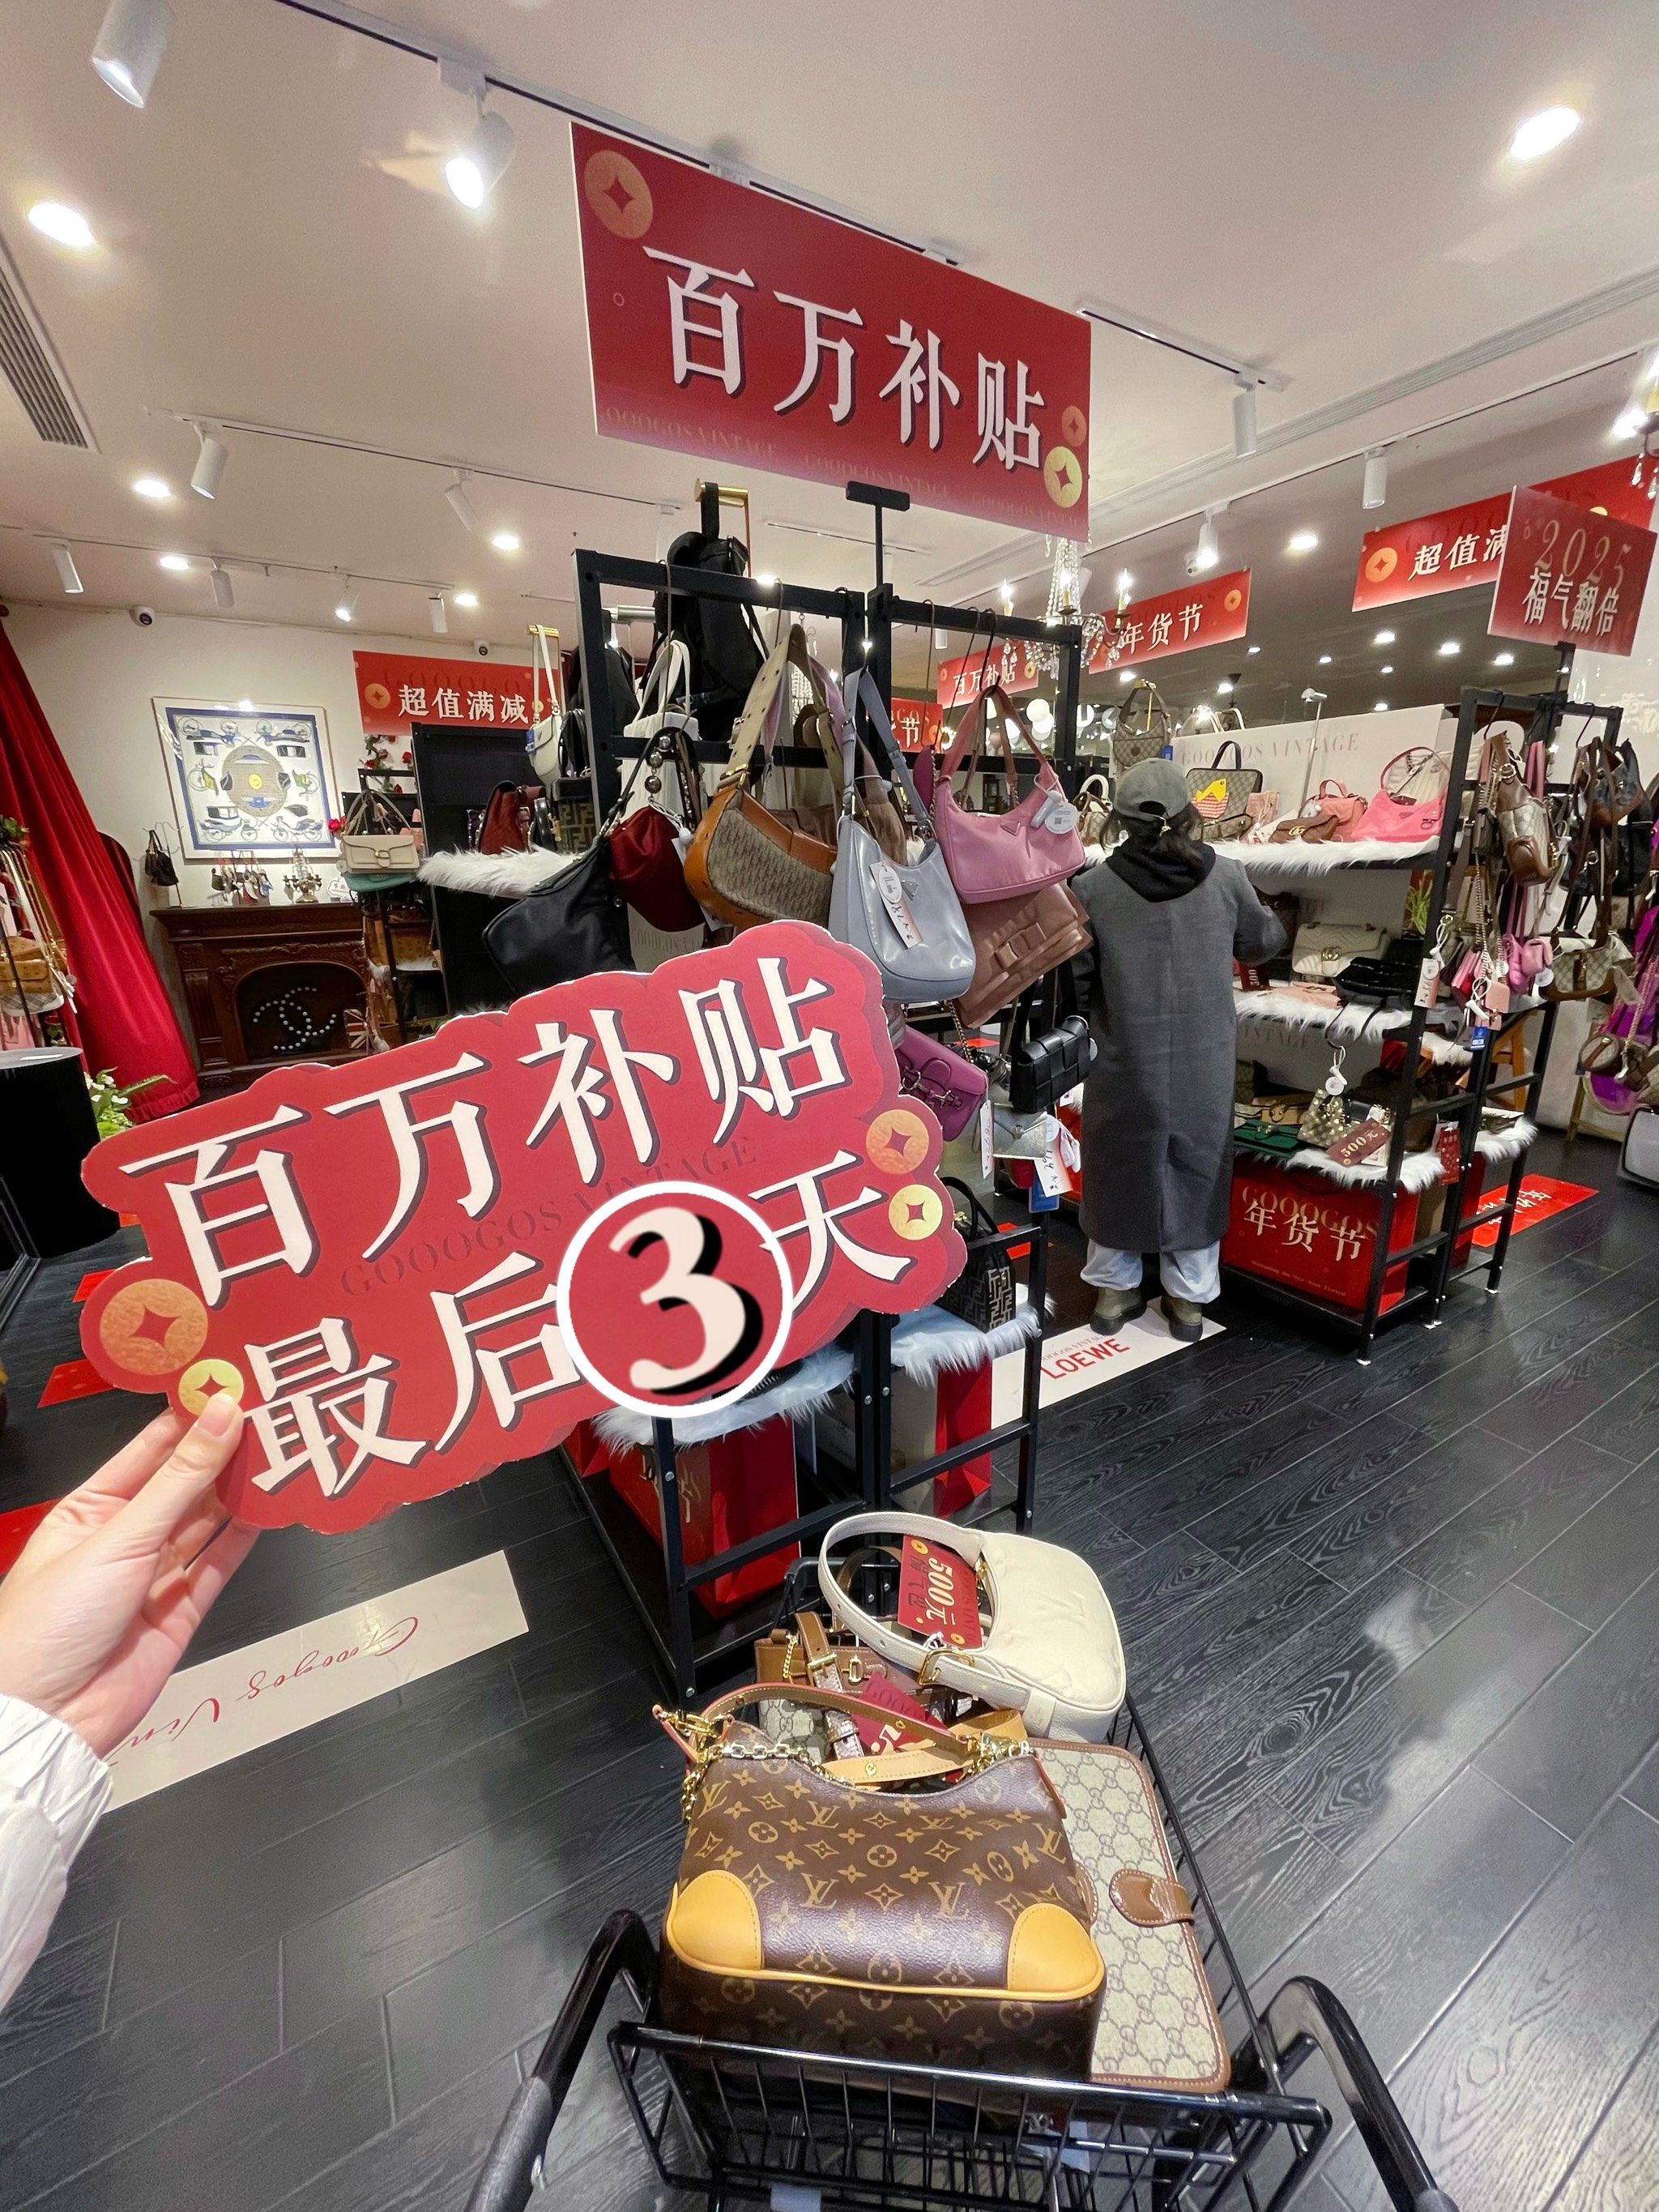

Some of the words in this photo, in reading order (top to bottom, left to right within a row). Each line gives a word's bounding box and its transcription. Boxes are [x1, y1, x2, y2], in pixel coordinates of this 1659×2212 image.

[643, 246, 1045, 470] 百万补贴
[1534, 519, 1632, 592] 2025
[1120, 603, 1205, 655] 年货节
[1522, 567, 1619, 637] 福气翻倍
[398, 684, 529, 724] 超值满减
[953, 664, 1017, 698] 百万补贴
[120, 957, 848, 1307] 百万补贴
[1340, 1129, 1379, 1158] 500元
[341, 1210, 563, 1297] GOOOGOS
[1243, 1201, 1367, 1262] 年货节
[1040, 1338, 1131, 1380] LOEWE
[924, 1557, 956, 1626] 500元
[106, 1697, 220, 1767] Vin
